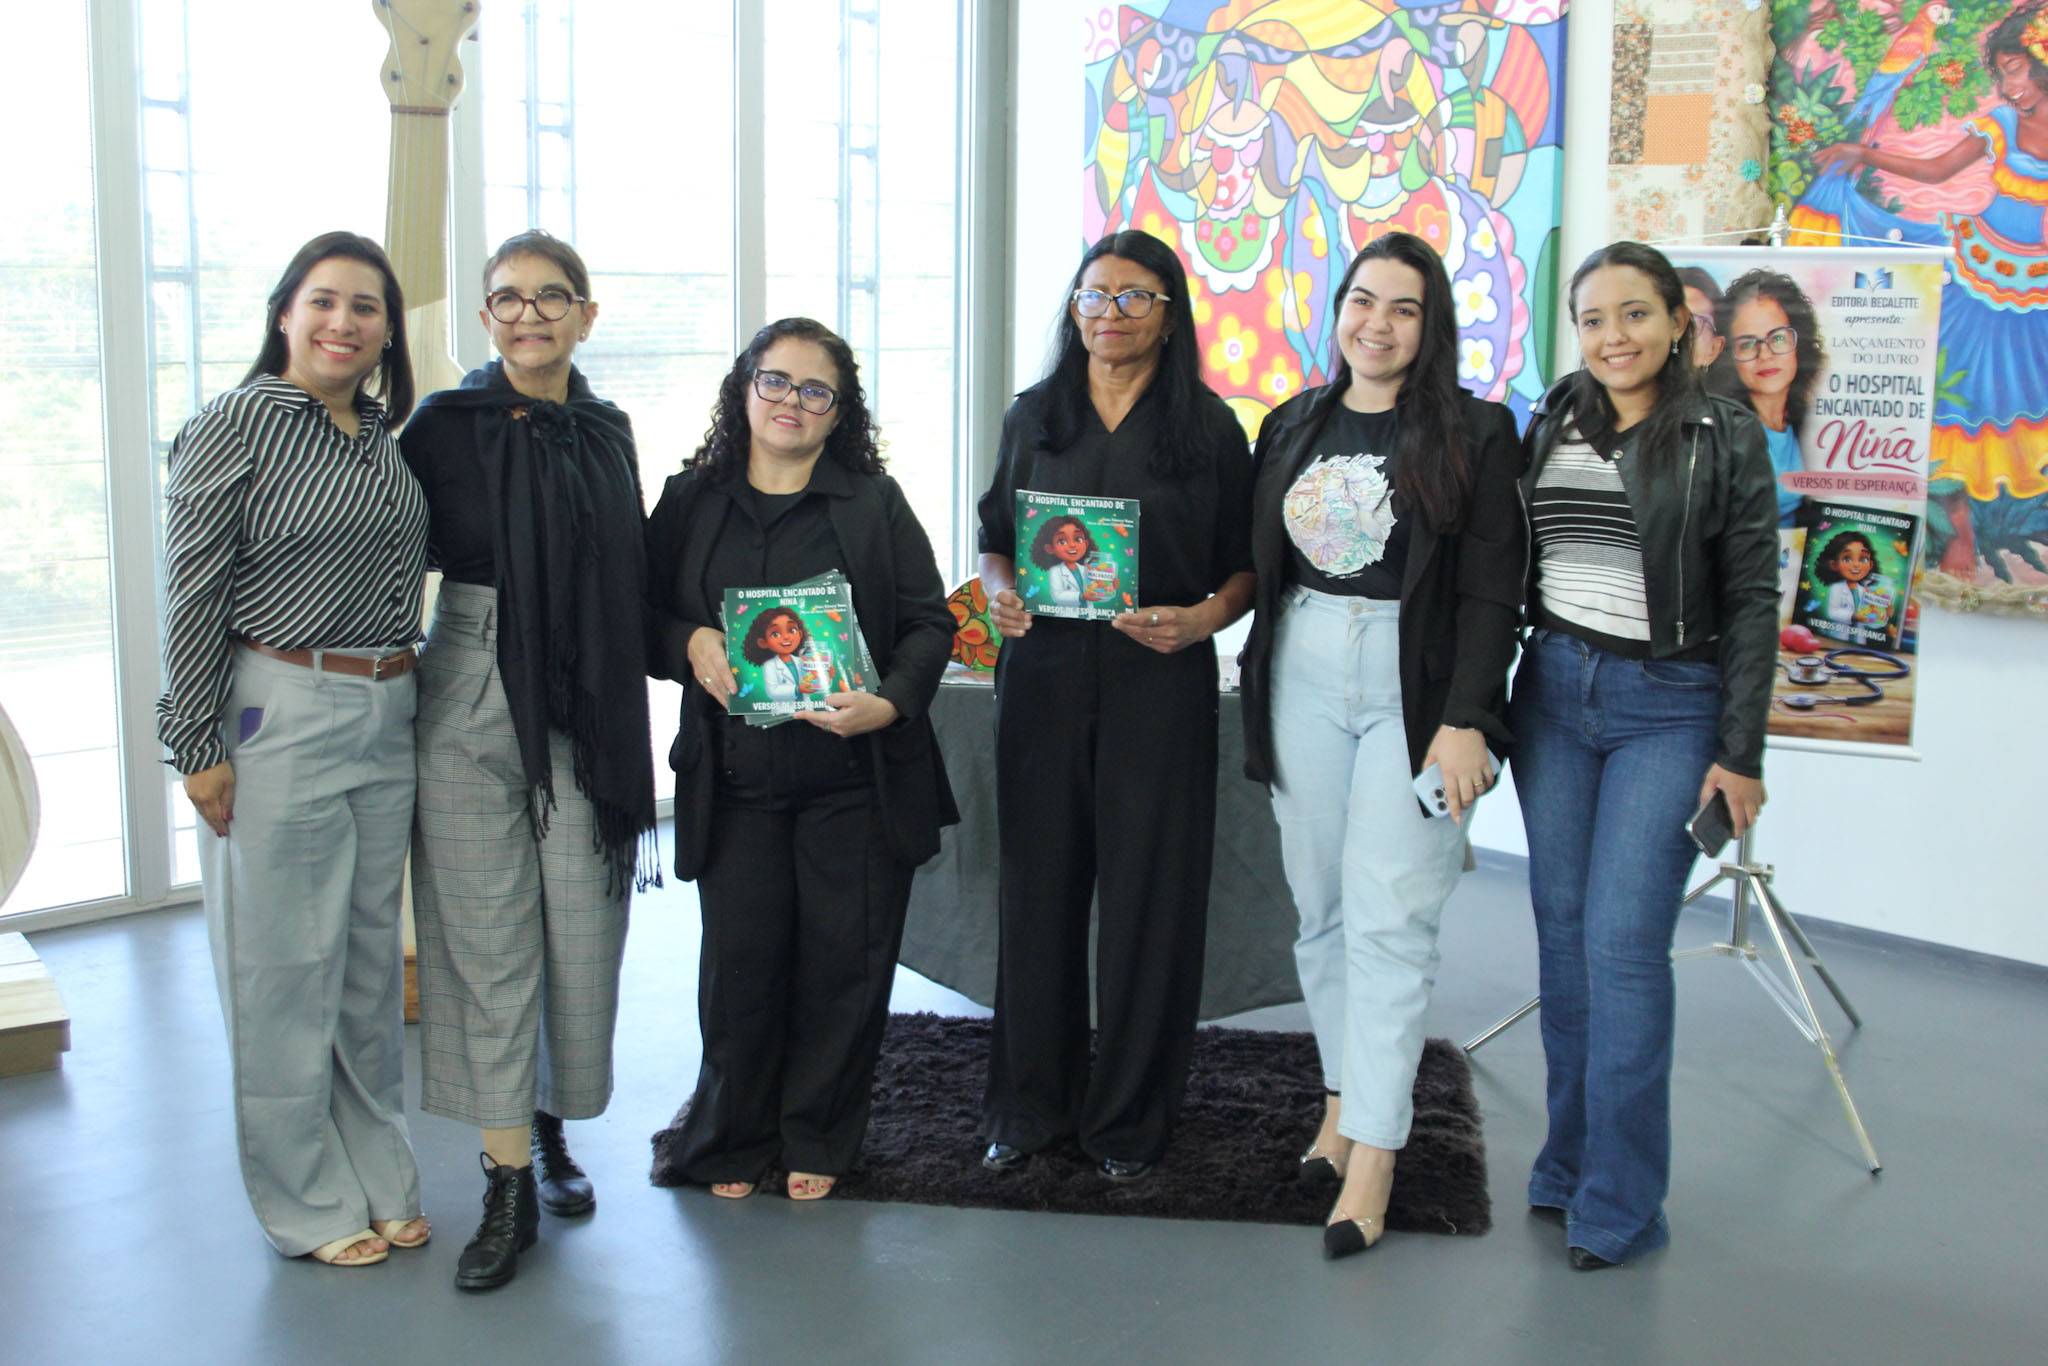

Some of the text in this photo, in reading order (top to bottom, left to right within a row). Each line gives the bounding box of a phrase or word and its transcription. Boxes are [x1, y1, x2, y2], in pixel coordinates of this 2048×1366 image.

[1832, 296, 1868, 308] EDITORA
[1832, 337, 1926, 351] LANÇAMENTO
[1853, 353, 1920, 366] DO LIVRO
[1829, 374, 1925, 396] O HOSPITAL
[1815, 398, 1926, 419] ENCANTADO DE
[1792, 477, 1919, 496] VERSOS DE ESPERANÇA
[1028, 495, 1125, 510] O HOSPITAL ENCANTADO DE
[1824, 507, 1912, 529] O HOSPITAL ENCANTADO
[738, 586, 837, 599] O HOSPITAL ENCANTADO DE
